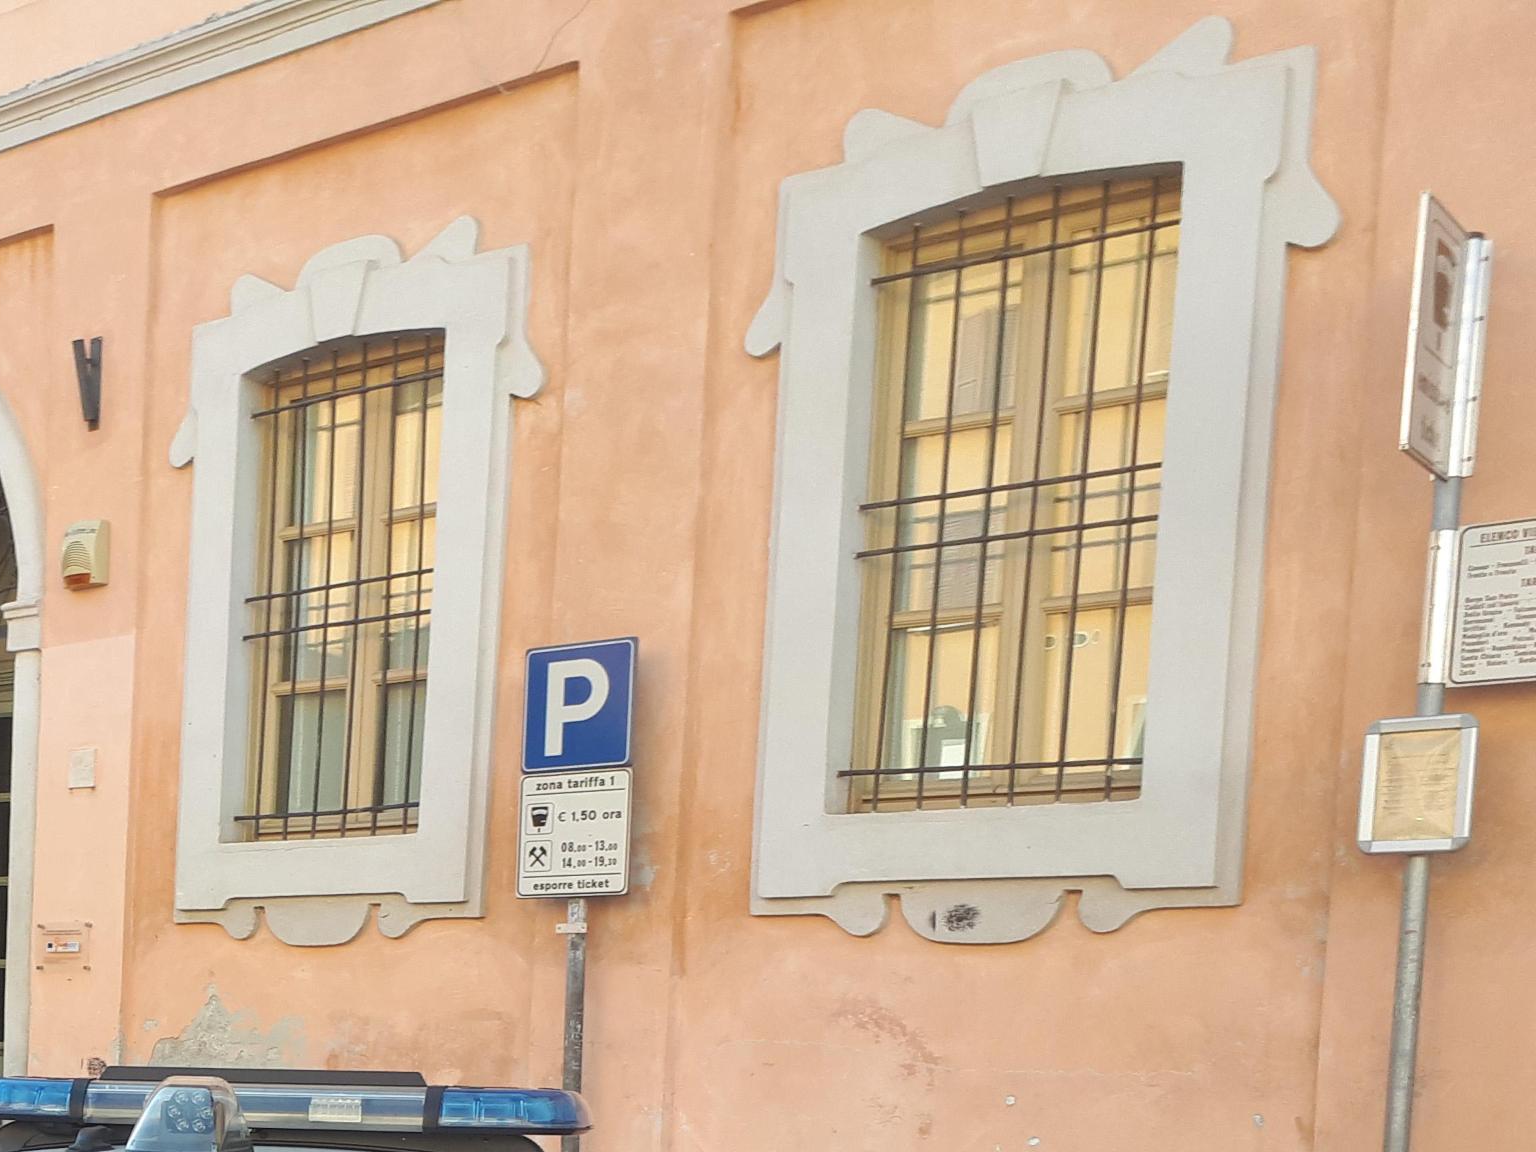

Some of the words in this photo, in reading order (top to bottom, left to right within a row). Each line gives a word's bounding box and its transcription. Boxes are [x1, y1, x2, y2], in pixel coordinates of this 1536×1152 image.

[544, 658, 610, 757] P
[536, 781, 563, 791] zona
[567, 776, 606, 789] tariffa
[609, 775, 615, 786] 1
[557, 811, 566, 822] €
[602, 810, 622, 820] ora
[533, 881, 574, 892] esporre
[577, 879, 610, 889] ticket
